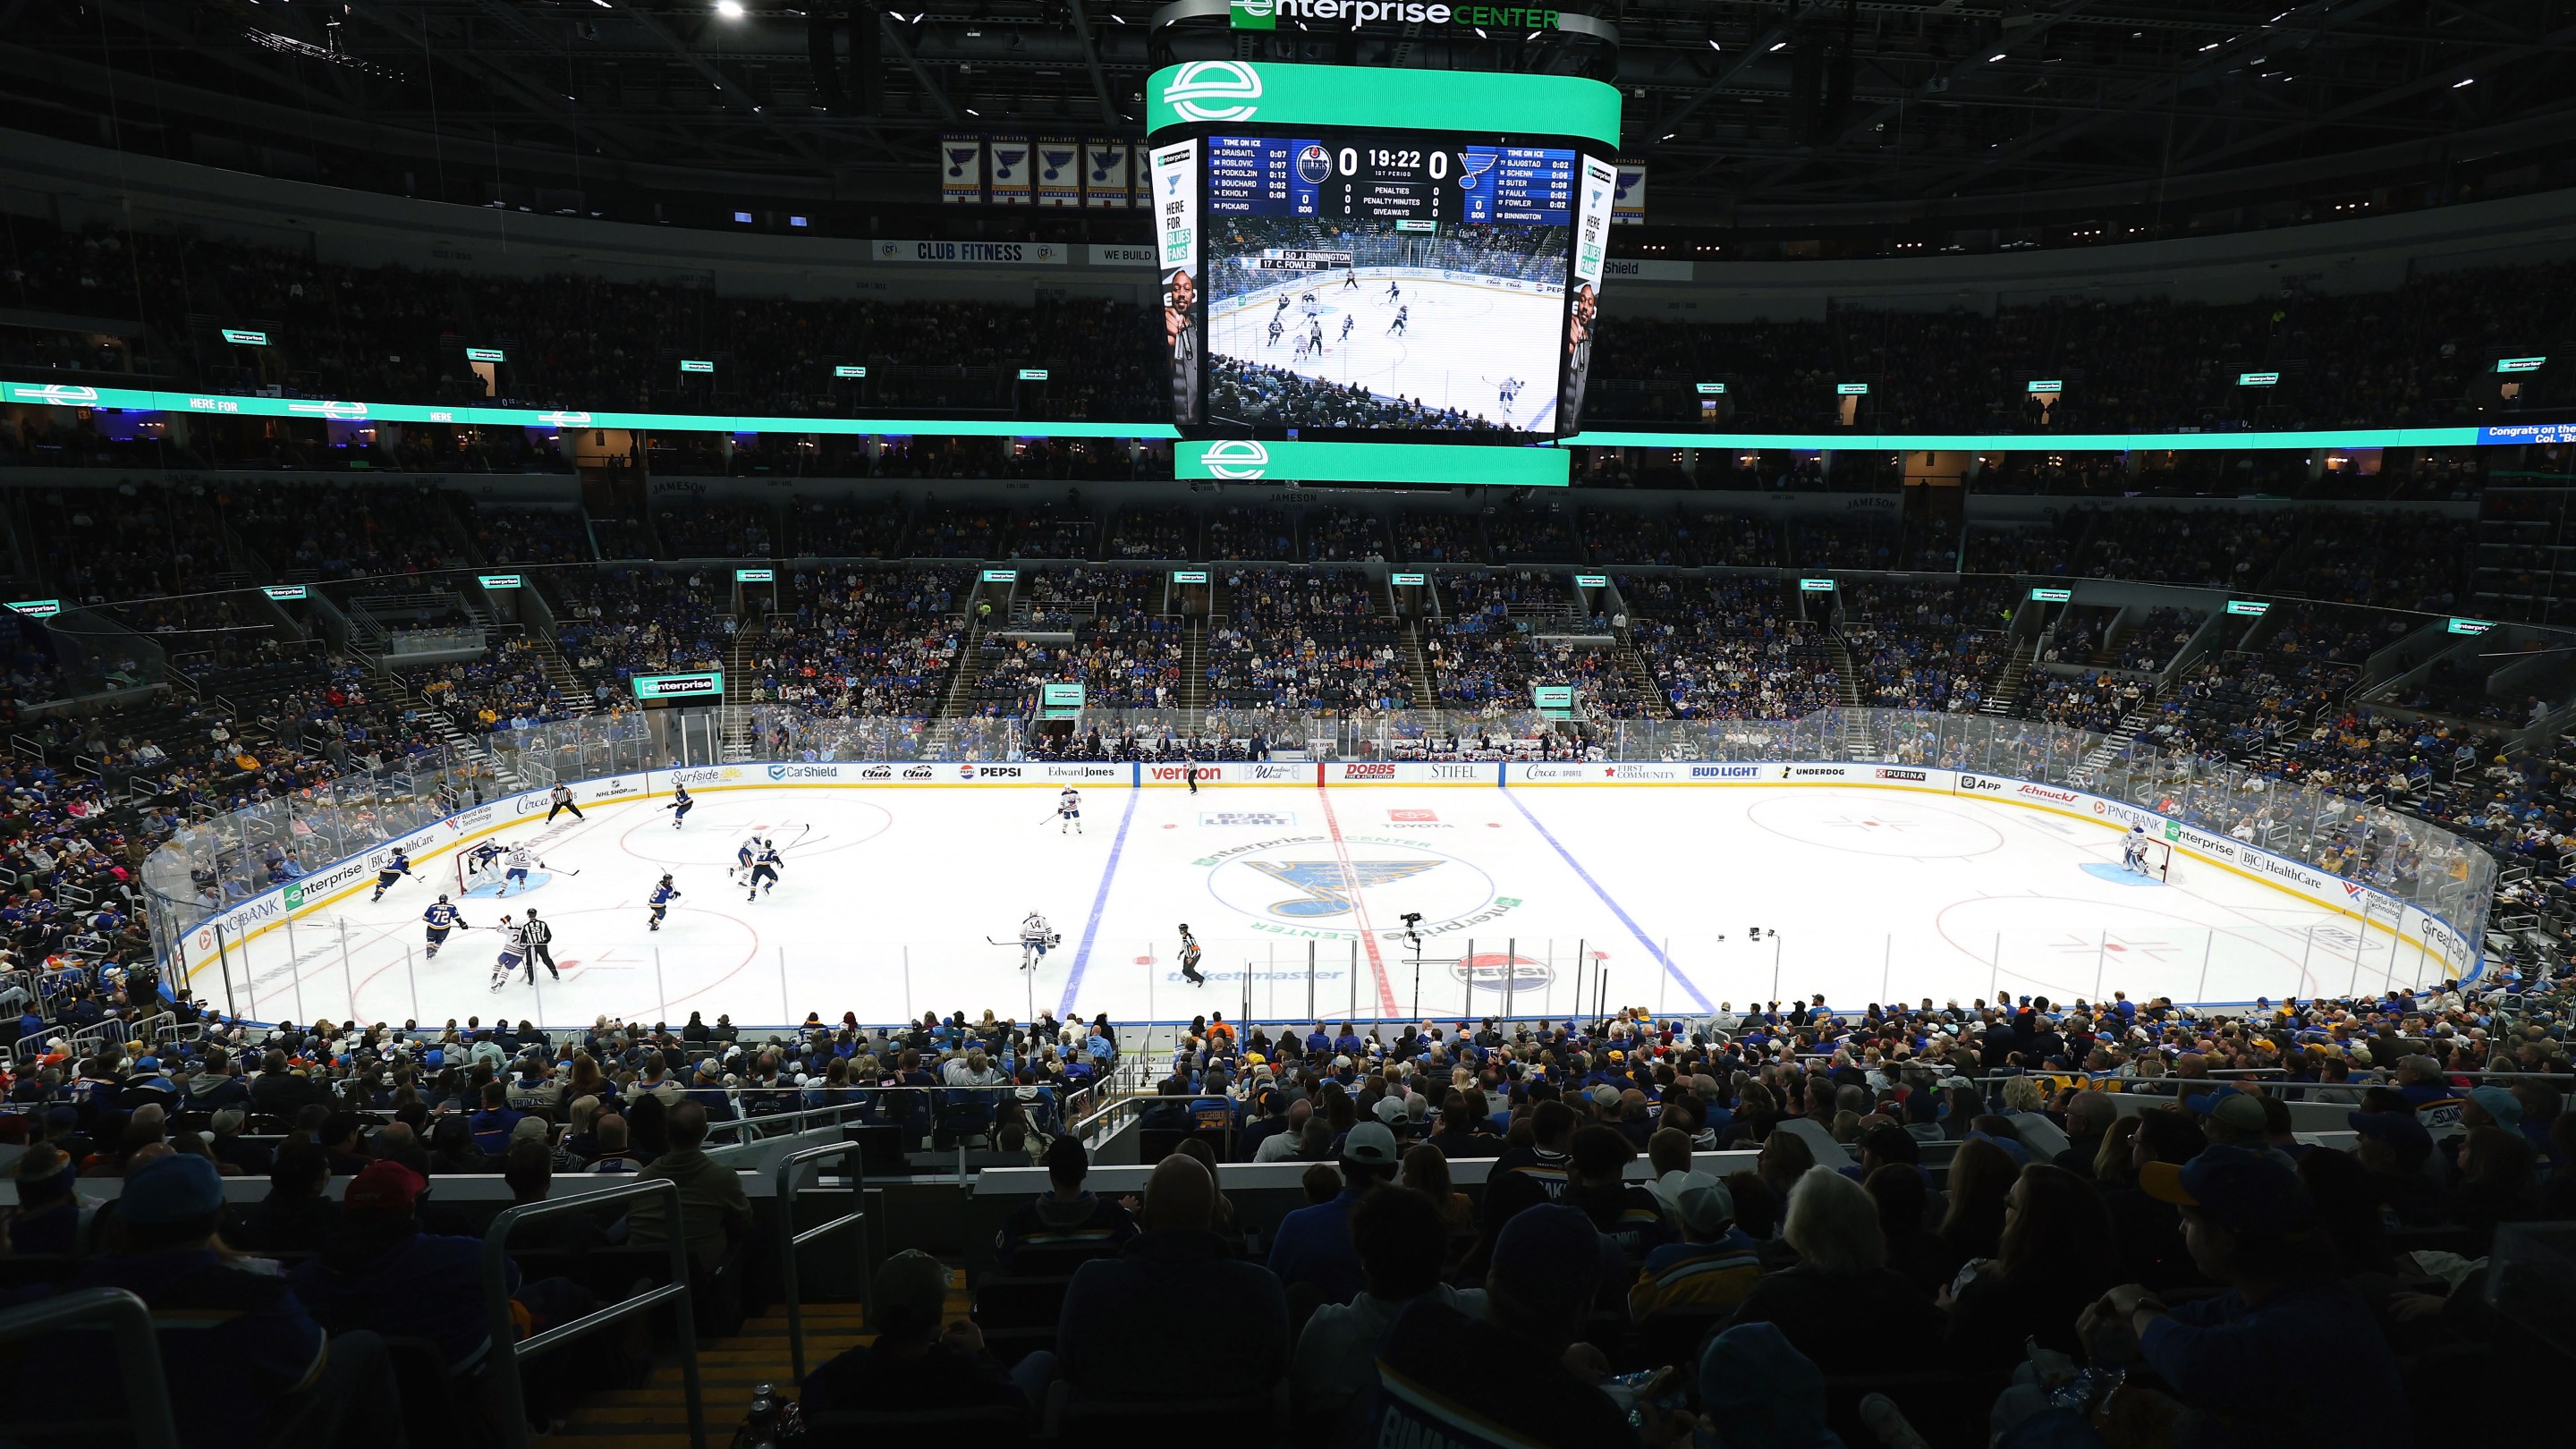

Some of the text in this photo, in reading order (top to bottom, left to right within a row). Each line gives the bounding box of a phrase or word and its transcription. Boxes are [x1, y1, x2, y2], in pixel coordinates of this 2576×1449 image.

[1231, 0, 1560, 29] enterprise CENTER
[1158, 151, 1190, 165] enterprise
[1221, 149, 1286, 158] DRAISAITL 0:07
[1368, 148, 1420, 168] 19:22
[1221, 159, 1286, 169] ROSLOVIC 0:07
[1339, 148, 1358, 176] 0
[1428, 151, 1447, 180] 0
[1507, 159, 1569, 169] BJUGSTAD 0:02
[1221, 169, 1286, 179] PODKOLZIN 0:12
[1506, 170, 1533, 178] SCHENN
[1588, 165, 1611, 183] enterprise
[1221, 180, 1257, 188] BOUCHARD
[1269, 182, 1286, 190] 0:02
[1506, 179, 1527, 187] SUTER
[1345, 183, 1439, 196] 0 PENALTIES 0
[1550, 191, 1566, 199] 0:02
[1302, 194, 1309, 204] 0
[1344, 194, 1438, 207] 0 PENALTY MINUTES 0
[1475, 200, 1482, 210] 0
[1504, 199, 1566, 209] FOWLER 0:02
[1165, 199, 1185, 216] HERE
[1221, 202, 1250, 210] PICKARD
[1344, 206, 1438, 217] 0 GIVEAWAYS 0
[1504, 212, 1541, 221] BINNINGTON
[1586, 214, 1601, 230] HERE
[1166, 216, 1181, 230] FOR
[1167, 229, 1191, 245] BLUES
[1584, 228, 1596, 243] FOR
[917, 242, 1022, 261] CLUB FITNESS
[1104, 250, 1151, 260] WE BUILD
[1167, 248, 1187, 261] FANS
[1583, 244, 1601, 260] BLUES
[1263, 259, 1272, 267] 17
[1580, 258, 1596, 275] FANS
[189, 397, 238, 412] HERE FOR
[429, 411, 453, 421] HERE
[2489, 426, 2539, 436] Congrats
[2557, 425, 2576, 433] the
[2535, 434, 2556, 443] Col.
[652, 481, 707, 496] JAMESON
[1269, 493, 1317, 504] JAMESON
[1845, 498, 1897, 511] JAMESON
[644, 680, 712, 691] enterprise
[786, 766, 837, 778] CarShield
[861, 767, 892, 778] Club
[902, 767, 933, 778] Club
[980, 767, 1021, 776] PEPSI
[1048, 766, 1114, 778] Edward Jones
[1151, 764, 1221, 780] verion
[1345, 764, 1395, 775] DOBBS
[1431, 764, 1477, 778] STIFEL
[1526, 764, 1558, 780] Circa
[1617, 771, 1676, 779] COMMUNITY
[1692, 767, 1758, 777] BUD LIGHT
[1886, 770, 1925, 780] PURINA
[671, 768, 719, 784] Surfside
[2016, 784, 2080, 802] Schnucks
[516, 796, 550, 815] Circa
[461, 806, 492, 820] World Wide
[462, 813, 492, 827] Technology
[2166, 825, 2234, 857] enterprise
[513, 852, 526, 861] 92
[1192, 835, 1432, 867] enterprise CENTER
[371, 852, 387, 868] BJC
[2243, 852, 2322, 889] BJC HealthCare
[285, 863, 362, 904] enterprise
[2367, 890, 2388, 905] World
[432, 911, 450, 923] 72
[530, 926, 540, 934] 55
[1031, 919, 1041, 929] 14
[1250, 921, 1359, 941] CENTER
[1456, 966, 1547, 978] PEPSI
[512, 1098, 545, 1107] THOMAS
